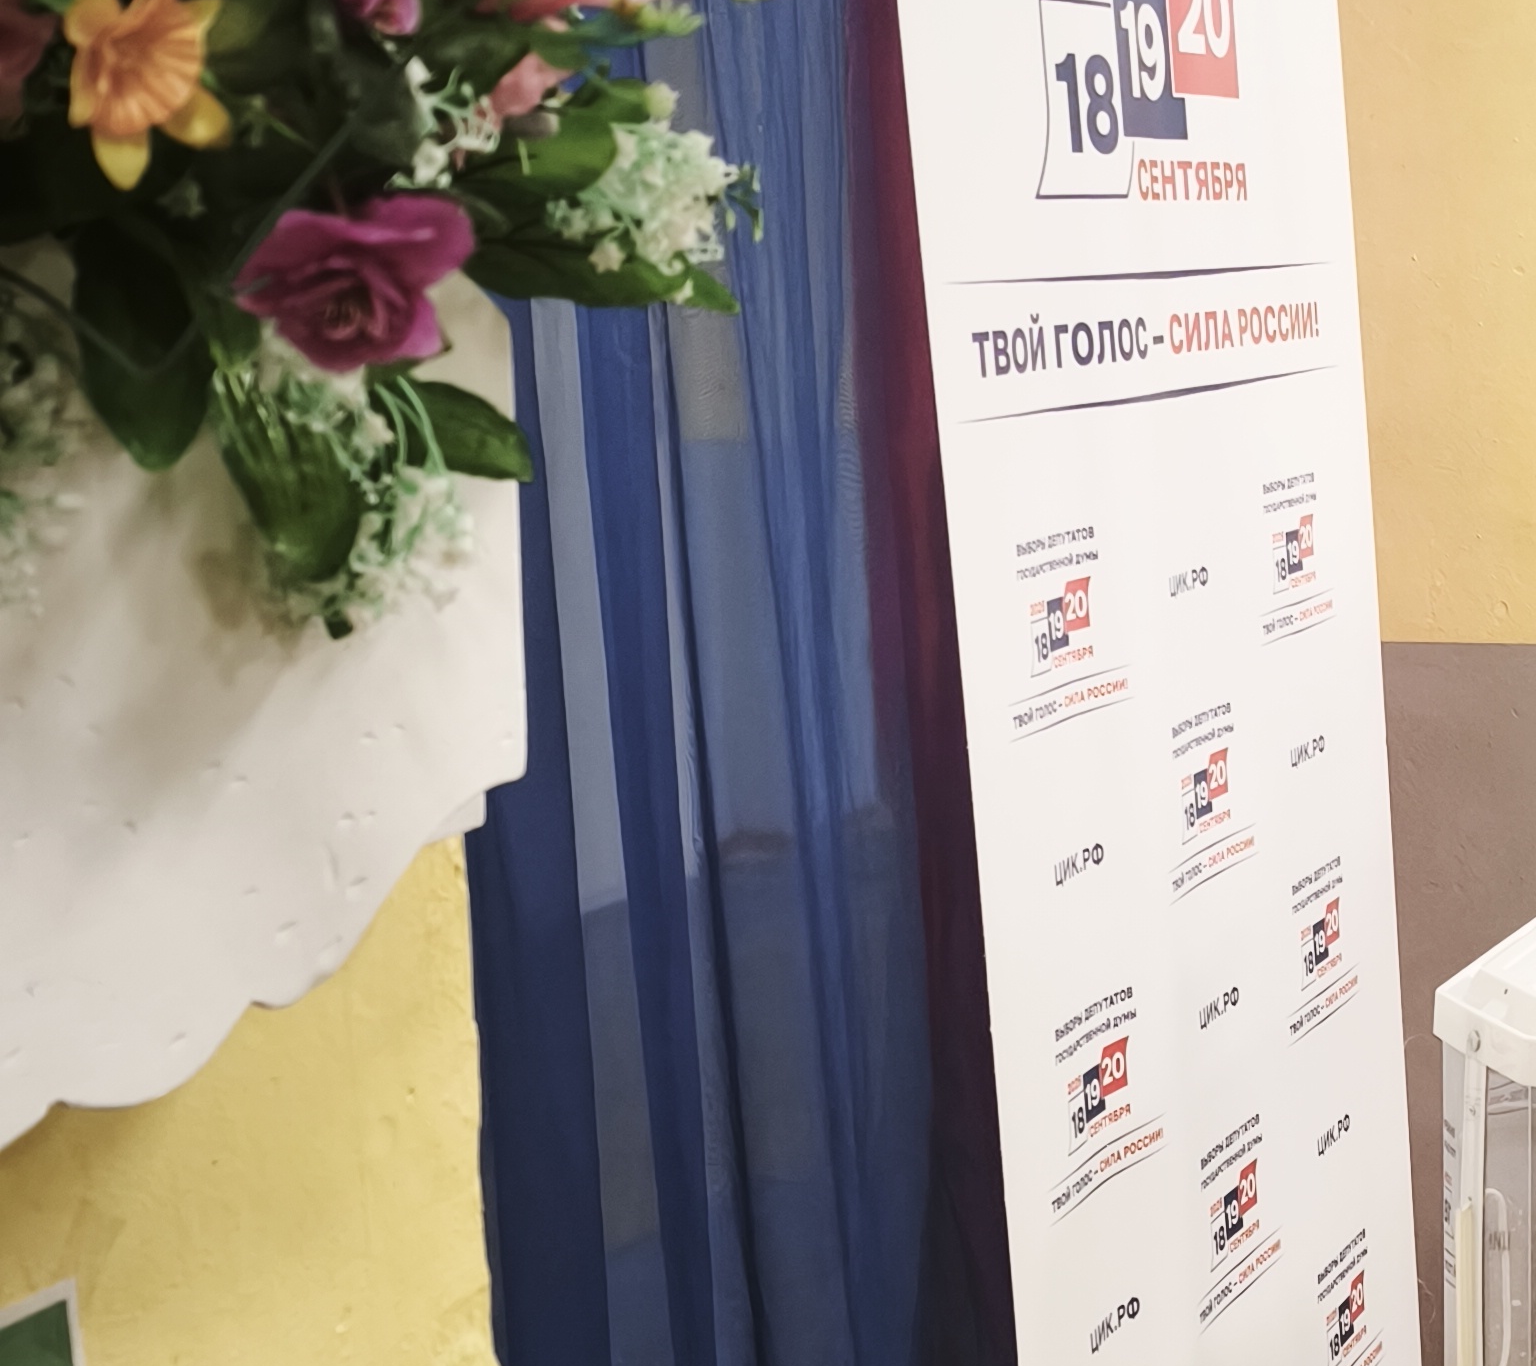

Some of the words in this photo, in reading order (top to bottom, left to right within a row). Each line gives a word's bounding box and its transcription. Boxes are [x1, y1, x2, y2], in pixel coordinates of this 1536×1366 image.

[1055, 52, 1119, 155] 18
[1119, 0, 1166, 102] 19
[1137, 158, 1248, 202] СЕНТЯБРЯ
[971, 313, 1046, 378] ТВОЙ
[1054, 317, 1149, 369] ГОЛОС
[1153, 336, 1164, 344] –
[1168, 310, 1234, 355] СИЛА
[1238, 301, 1321, 348] РОССИИ!
[1048, 526, 1094, 549] ДЕПУТАТОВ
[1275, 557, 1287, 582] 18
[1287, 540, 1300, 566] 19
[1300, 524, 1312, 549] 20
[1168, 566, 1209, 597] ЦИК.РФ
[1035, 632, 1048, 663] 18
[1048, 609, 1064, 640] 19
[1064, 589, 1088, 621] 20
[1087, 678, 1128, 700] РОССИИ!
[1290, 735, 1325, 768] ЦИК.РФ
[1185, 803, 1195, 830] 18
[1195, 780, 1208, 809] 19
[1209, 760, 1226, 789] 20
[1053, 842, 1105, 887] ЦИК.РФ
[1304, 951, 1314, 976] 18
[1315, 930, 1325, 955] 19
[1326, 908, 1338, 937] 20
[1055, 1012, 1083, 1042] ВЫБОРЫ
[1084, 986, 1133, 1021] ДЕПУТАТОВ
[1112, 1008, 1137, 1029] ДУМЫ
[1198, 986, 1240, 1031] ЦИК.РФ
[1072, 1106, 1085, 1139] 18
[1084, 1078, 1101, 1110] 19
[1101, 1051, 1125, 1087] 20
[1088, 1103, 1131, 1138] СЕНТЯБРЯ
[1317, 1114, 1351, 1157] ЦИК.РФ
[1051, 1185, 1071, 1213] ТВОЙ
[1099, 1148, 1122, 1173] СИЛА
[1123, 1127, 1164, 1158] РОССИИ!
[1213, 1225, 1226, 1256] 18
[1225, 1199, 1239, 1229] 19
[1240, 1173, 1256, 1205] 20
[1089, 1296, 1141, 1355] ЦИК.РФ
[1329, 1333, 1340, 1361] 18
[1340, 1313, 1350, 1335] 19
[1351, 1282, 1363, 1310] 20
